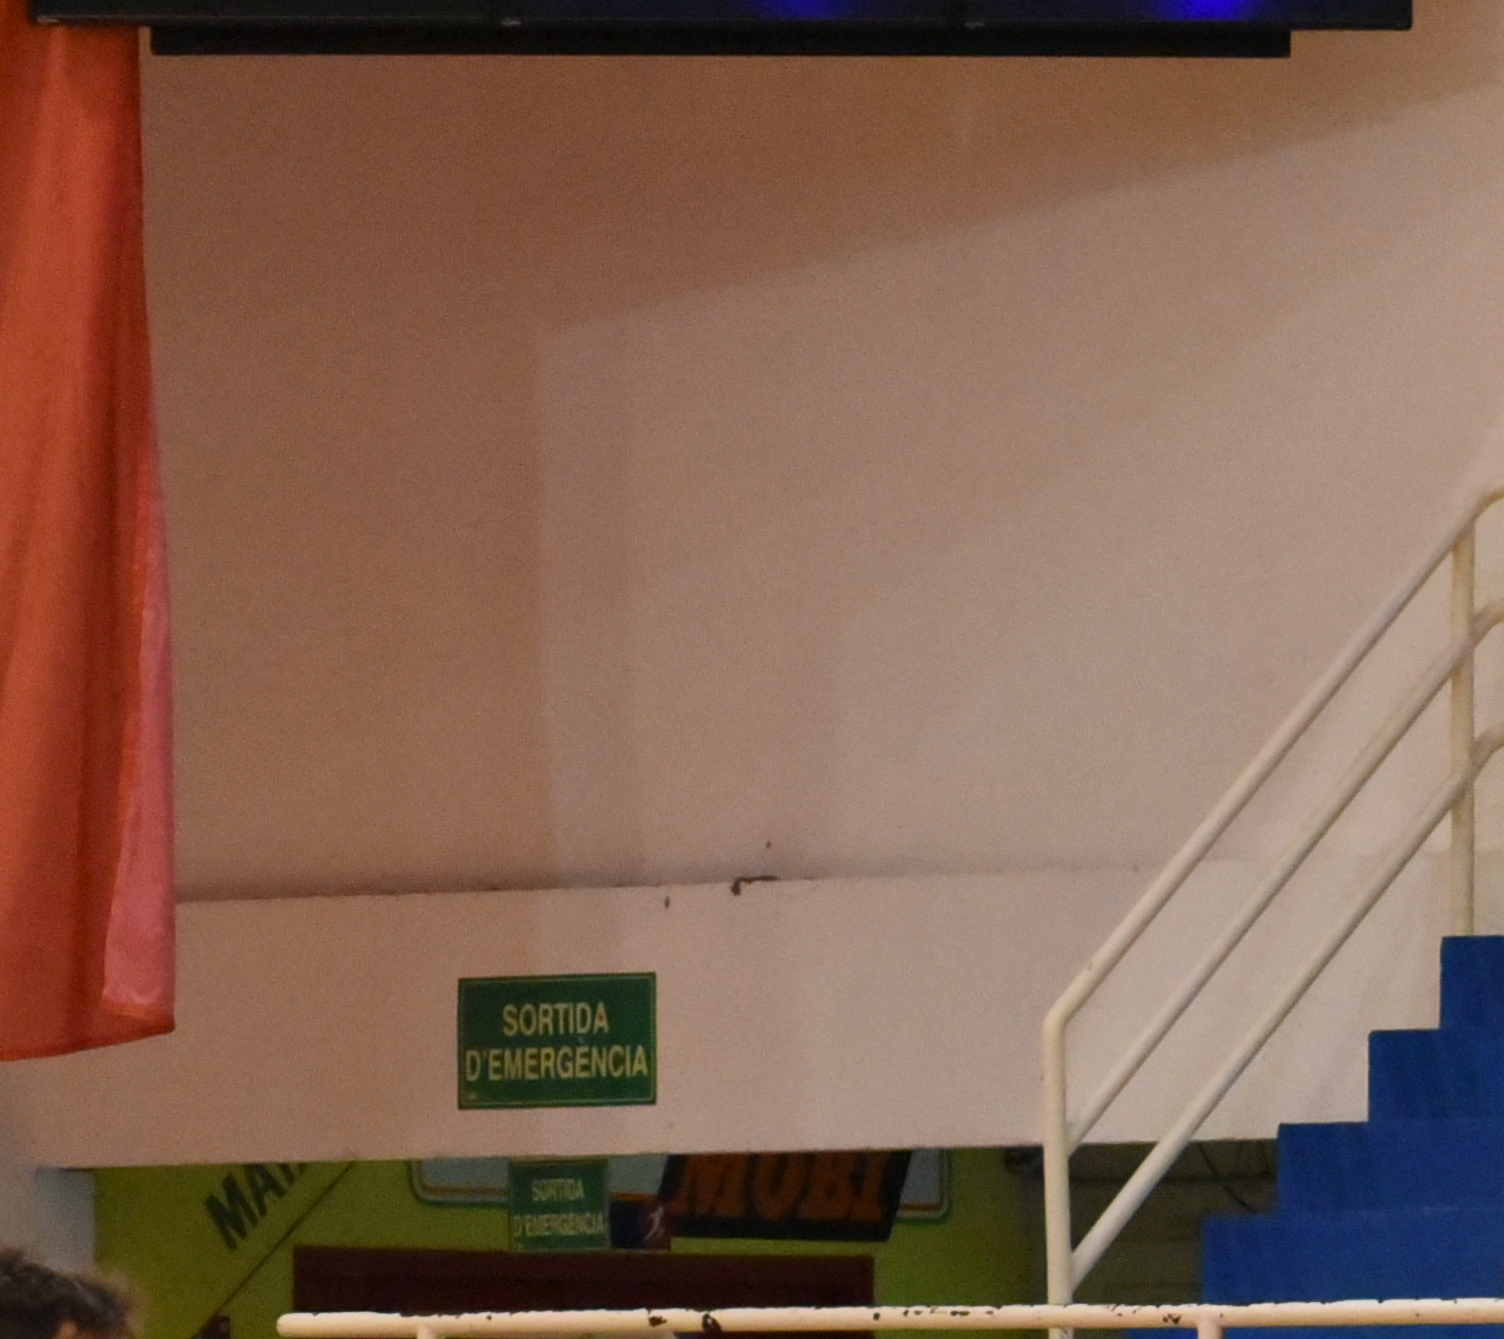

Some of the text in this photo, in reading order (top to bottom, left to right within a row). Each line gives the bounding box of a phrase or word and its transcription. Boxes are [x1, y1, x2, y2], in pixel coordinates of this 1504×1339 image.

[501, 1000, 610, 1038] SORTIDA
[464, 1035, 649, 1083] D'EMERGÈNCIA
[531, 1177, 585, 1203] SORTIDA
